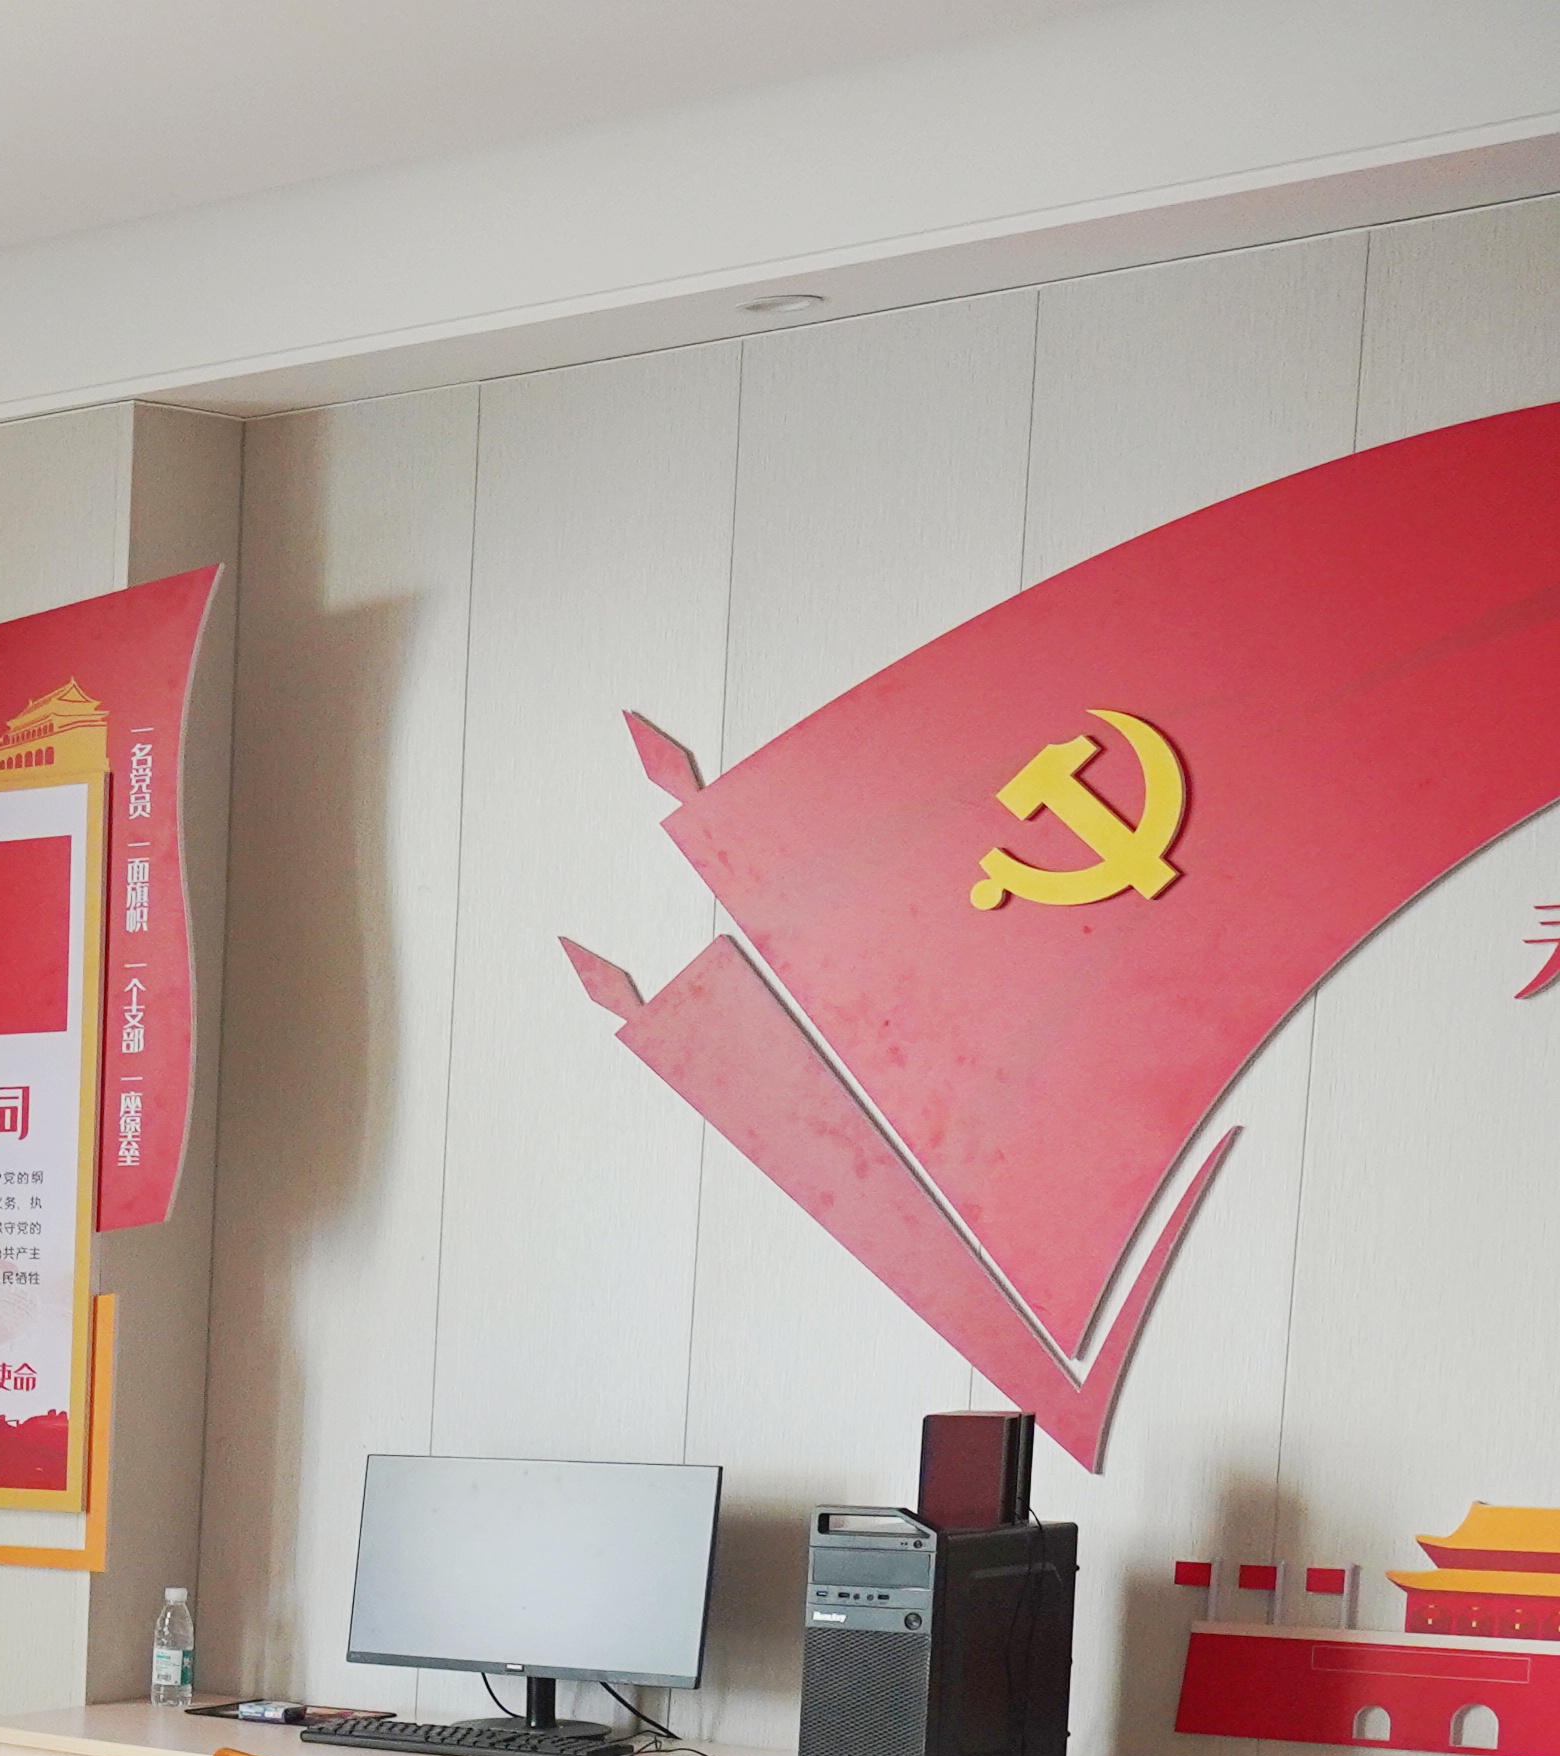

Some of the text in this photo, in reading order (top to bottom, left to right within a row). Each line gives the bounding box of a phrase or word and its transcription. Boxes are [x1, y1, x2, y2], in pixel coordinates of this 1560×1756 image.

[117, 727, 154, 1167] 一名党员 一面旗帜 一个支部 一座堡垒
